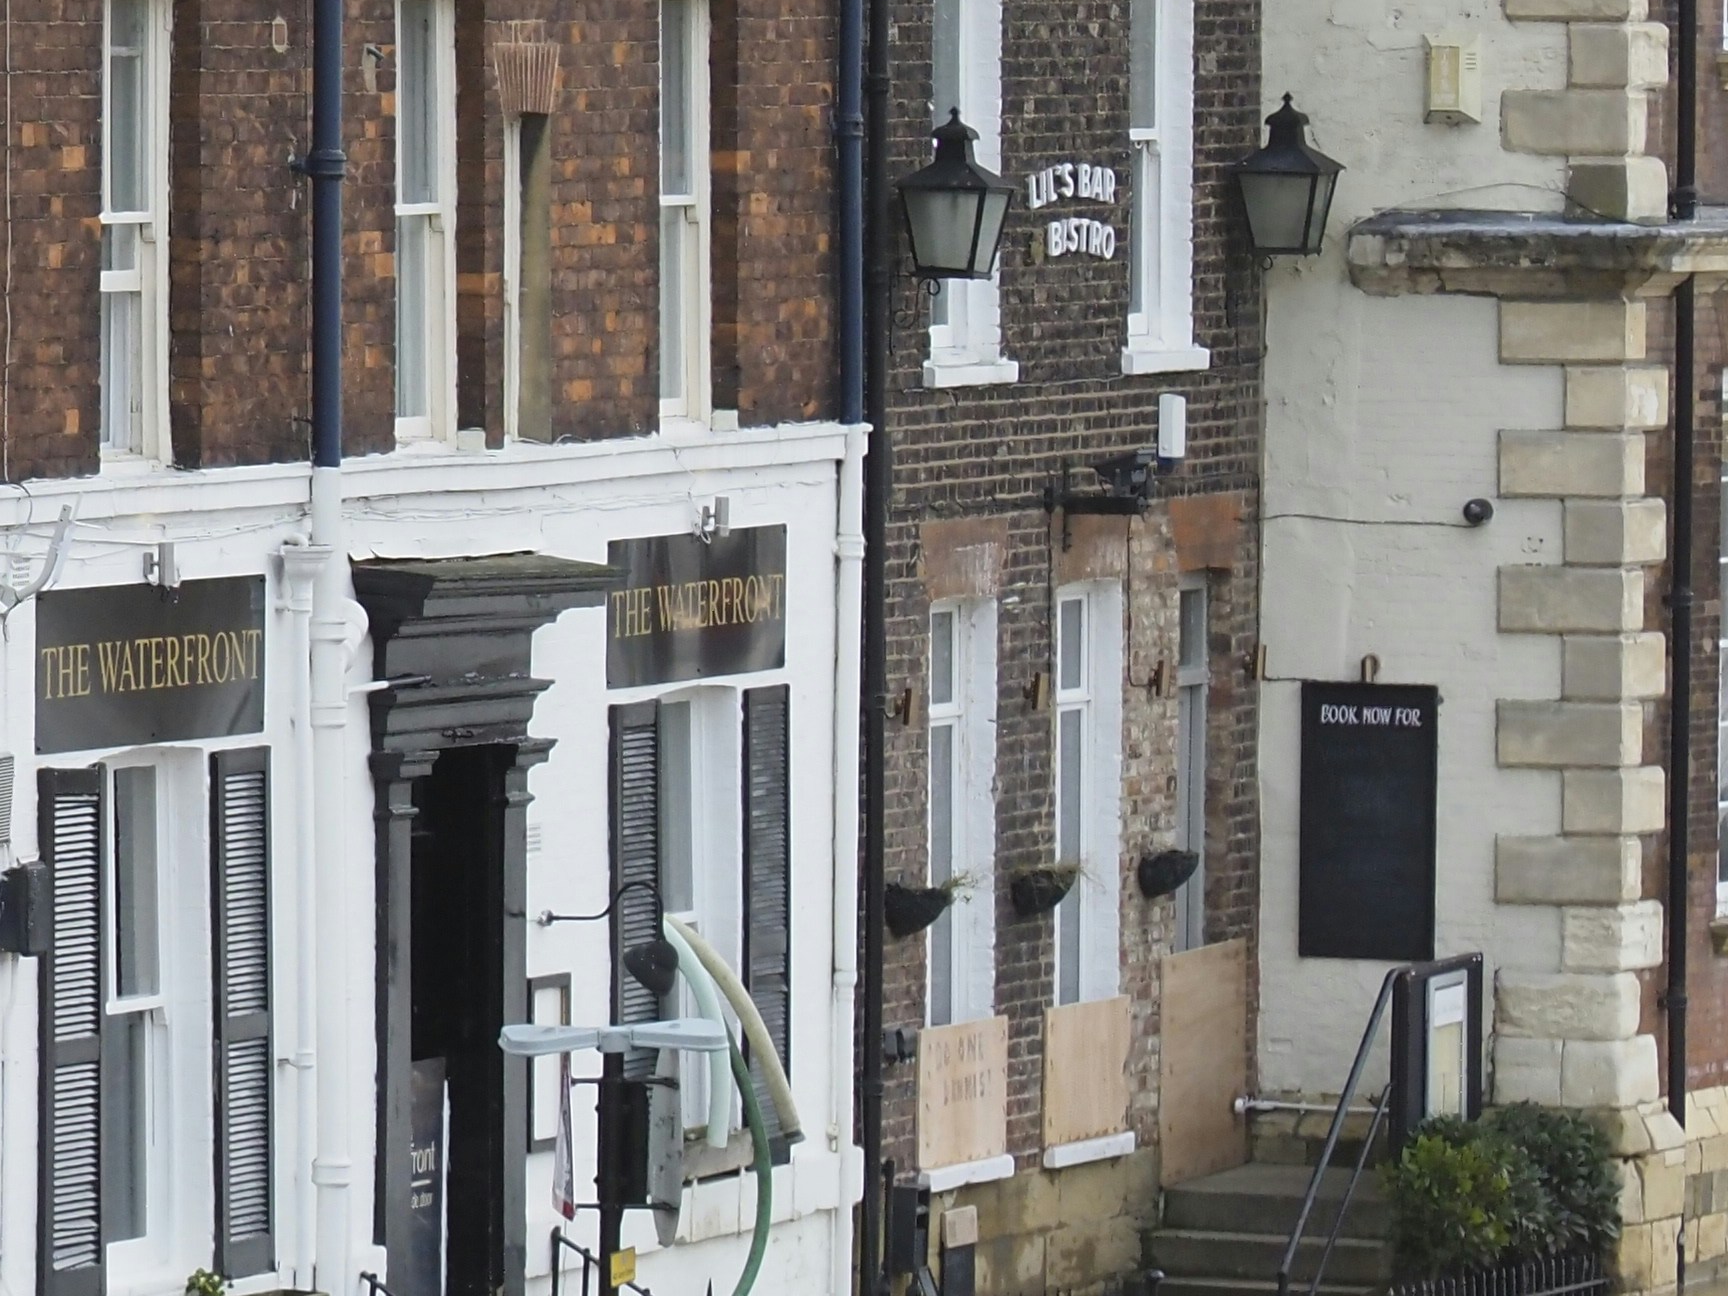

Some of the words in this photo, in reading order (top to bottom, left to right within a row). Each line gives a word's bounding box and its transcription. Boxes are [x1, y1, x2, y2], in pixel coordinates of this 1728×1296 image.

[1027, 163, 1075, 209] LIL'S
[1078, 163, 1116, 204] BAR
[1047, 218, 1116, 261] BISTRO
[612, 586, 652, 640] THE
[657, 573, 784, 634] WATERFRONT
[42, 643, 91, 701] THE
[97, 629, 263, 695] WATERFRONT
[1321, 703, 1359, 725] BOOK
[1362, 707, 1392, 725] NOW
[1395, 708, 1423, 728] FOR
